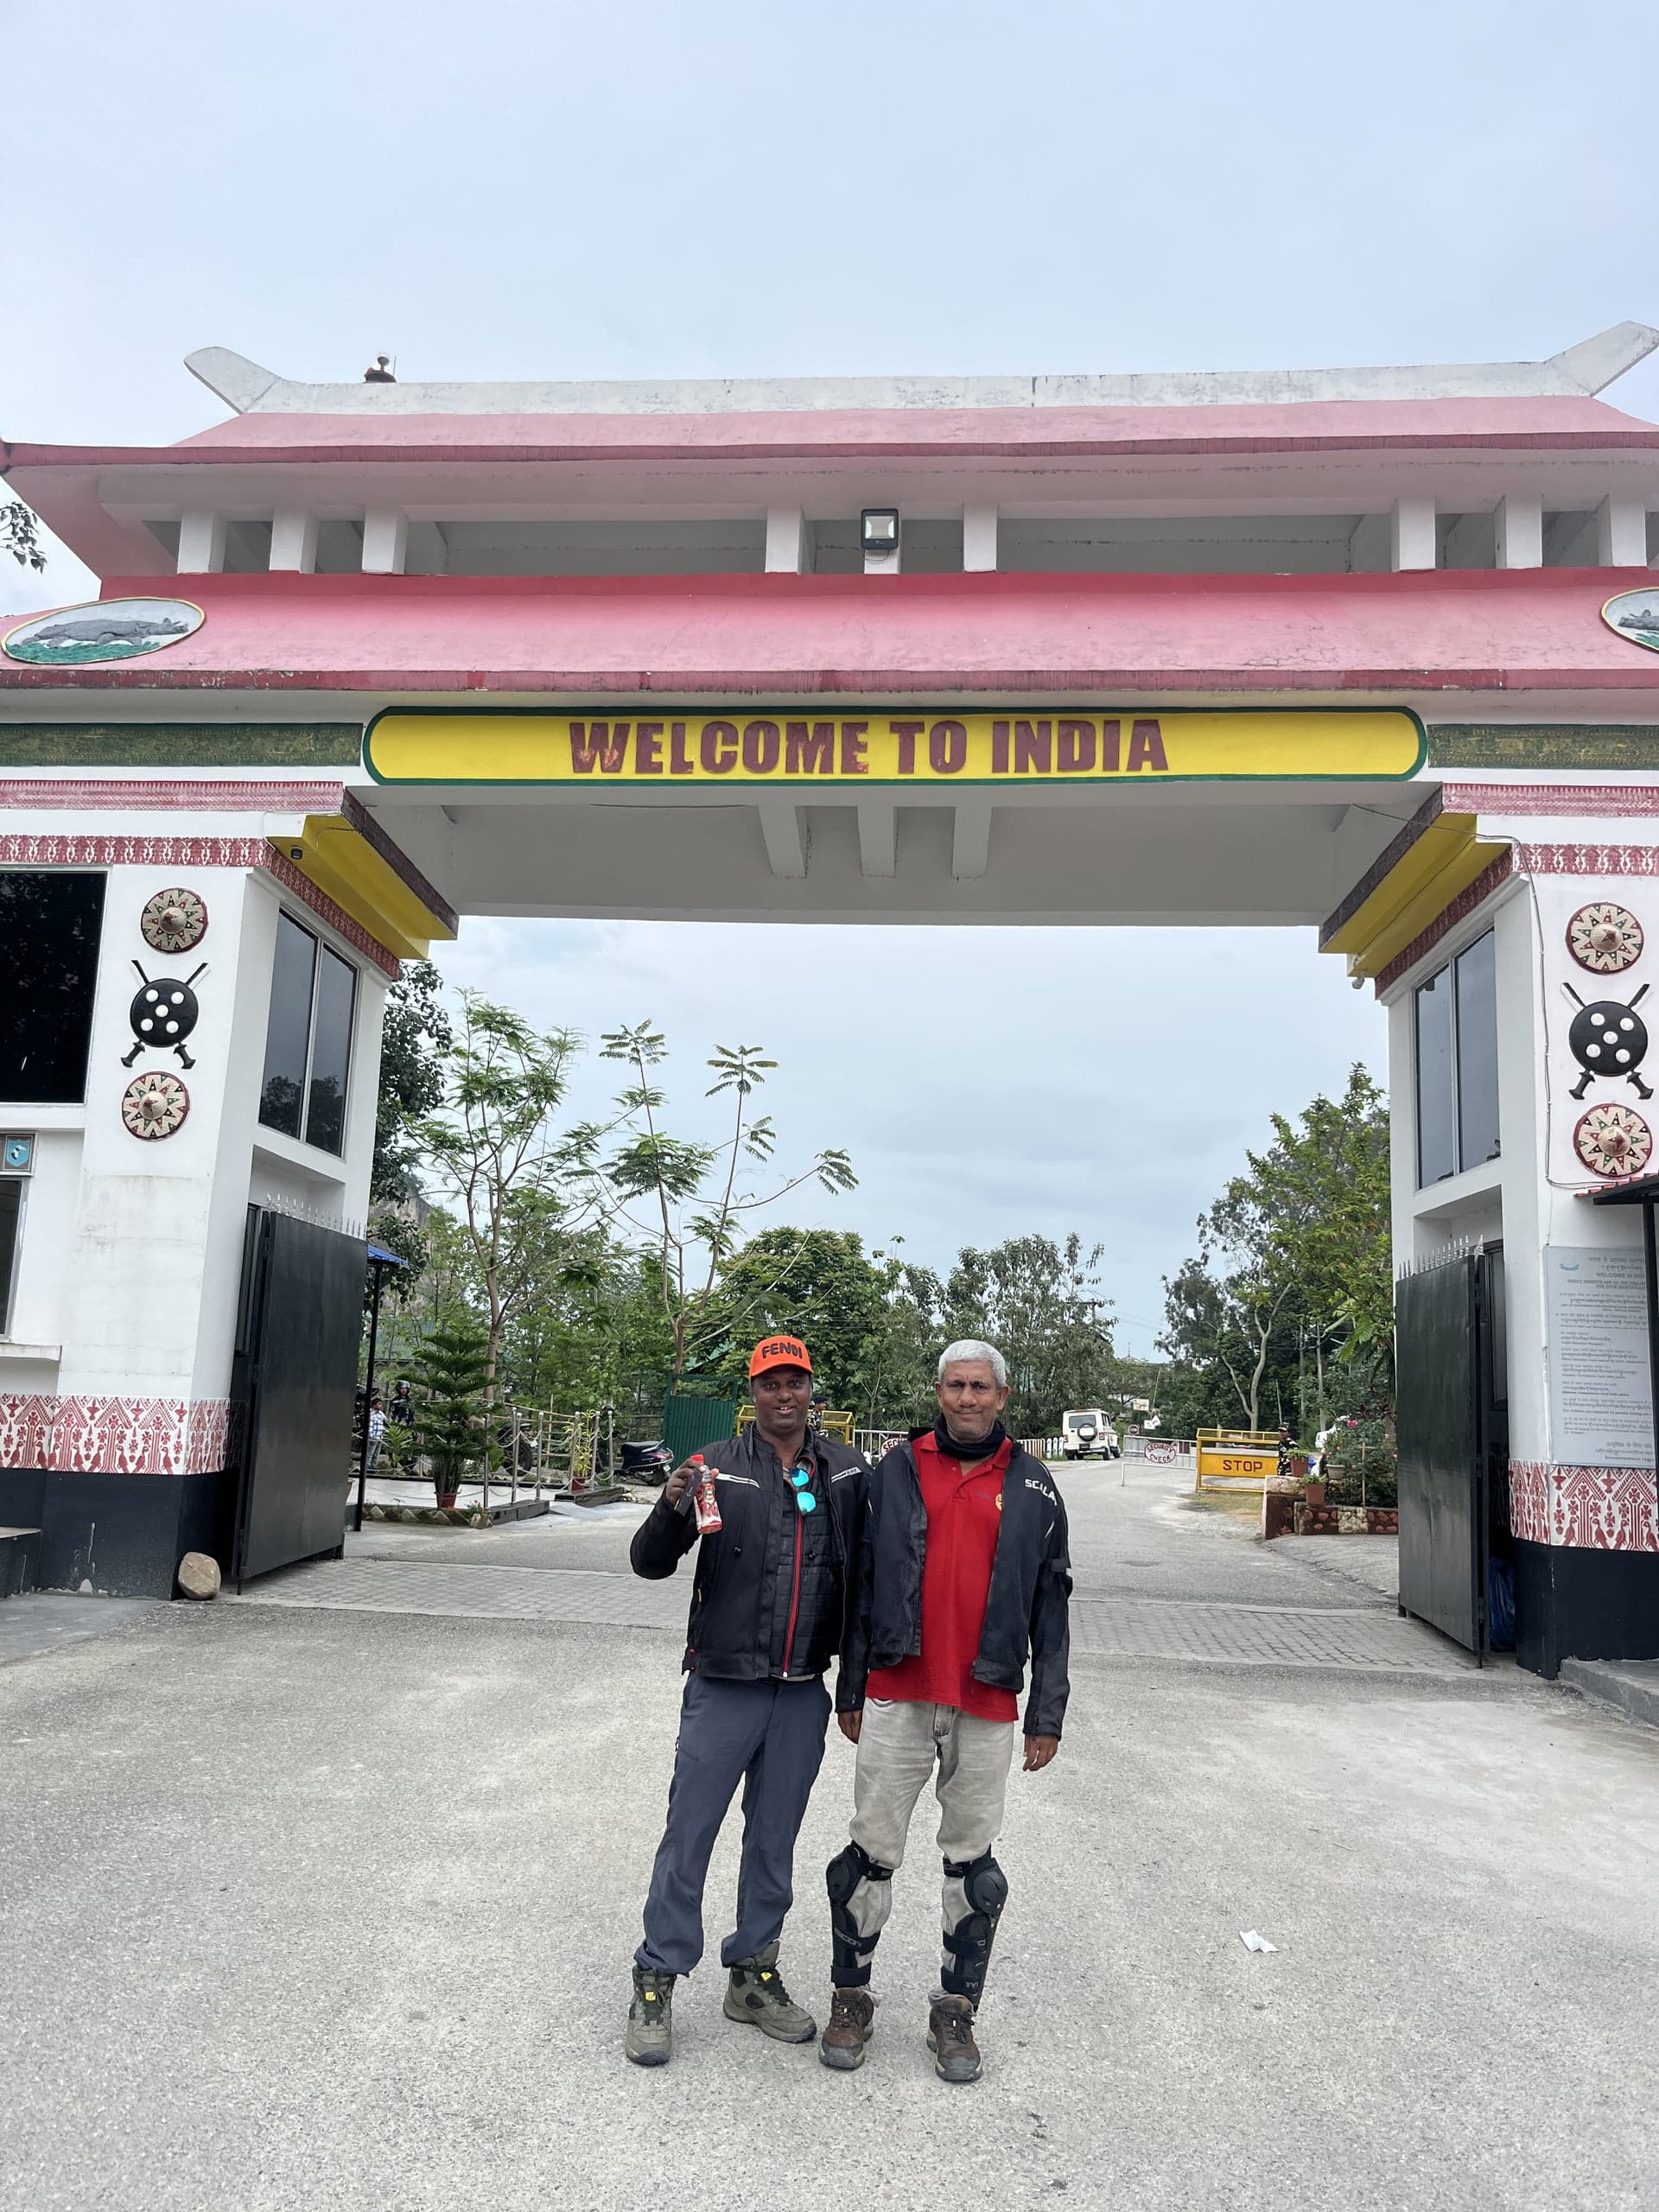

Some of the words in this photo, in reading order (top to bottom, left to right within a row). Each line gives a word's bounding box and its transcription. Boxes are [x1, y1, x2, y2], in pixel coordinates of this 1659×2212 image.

[569, 721, 869, 775] WELCOME
[889, 720, 967, 775] TO
[992, 719, 1169, 773] INDIA
[761, 1342, 803, 1359] FENDI
[1147, 1443, 1174, 1453] SECURITY
[1149, 1453, 1172, 1464] CHECK
[1223, 1459, 1262, 1472] STOP
